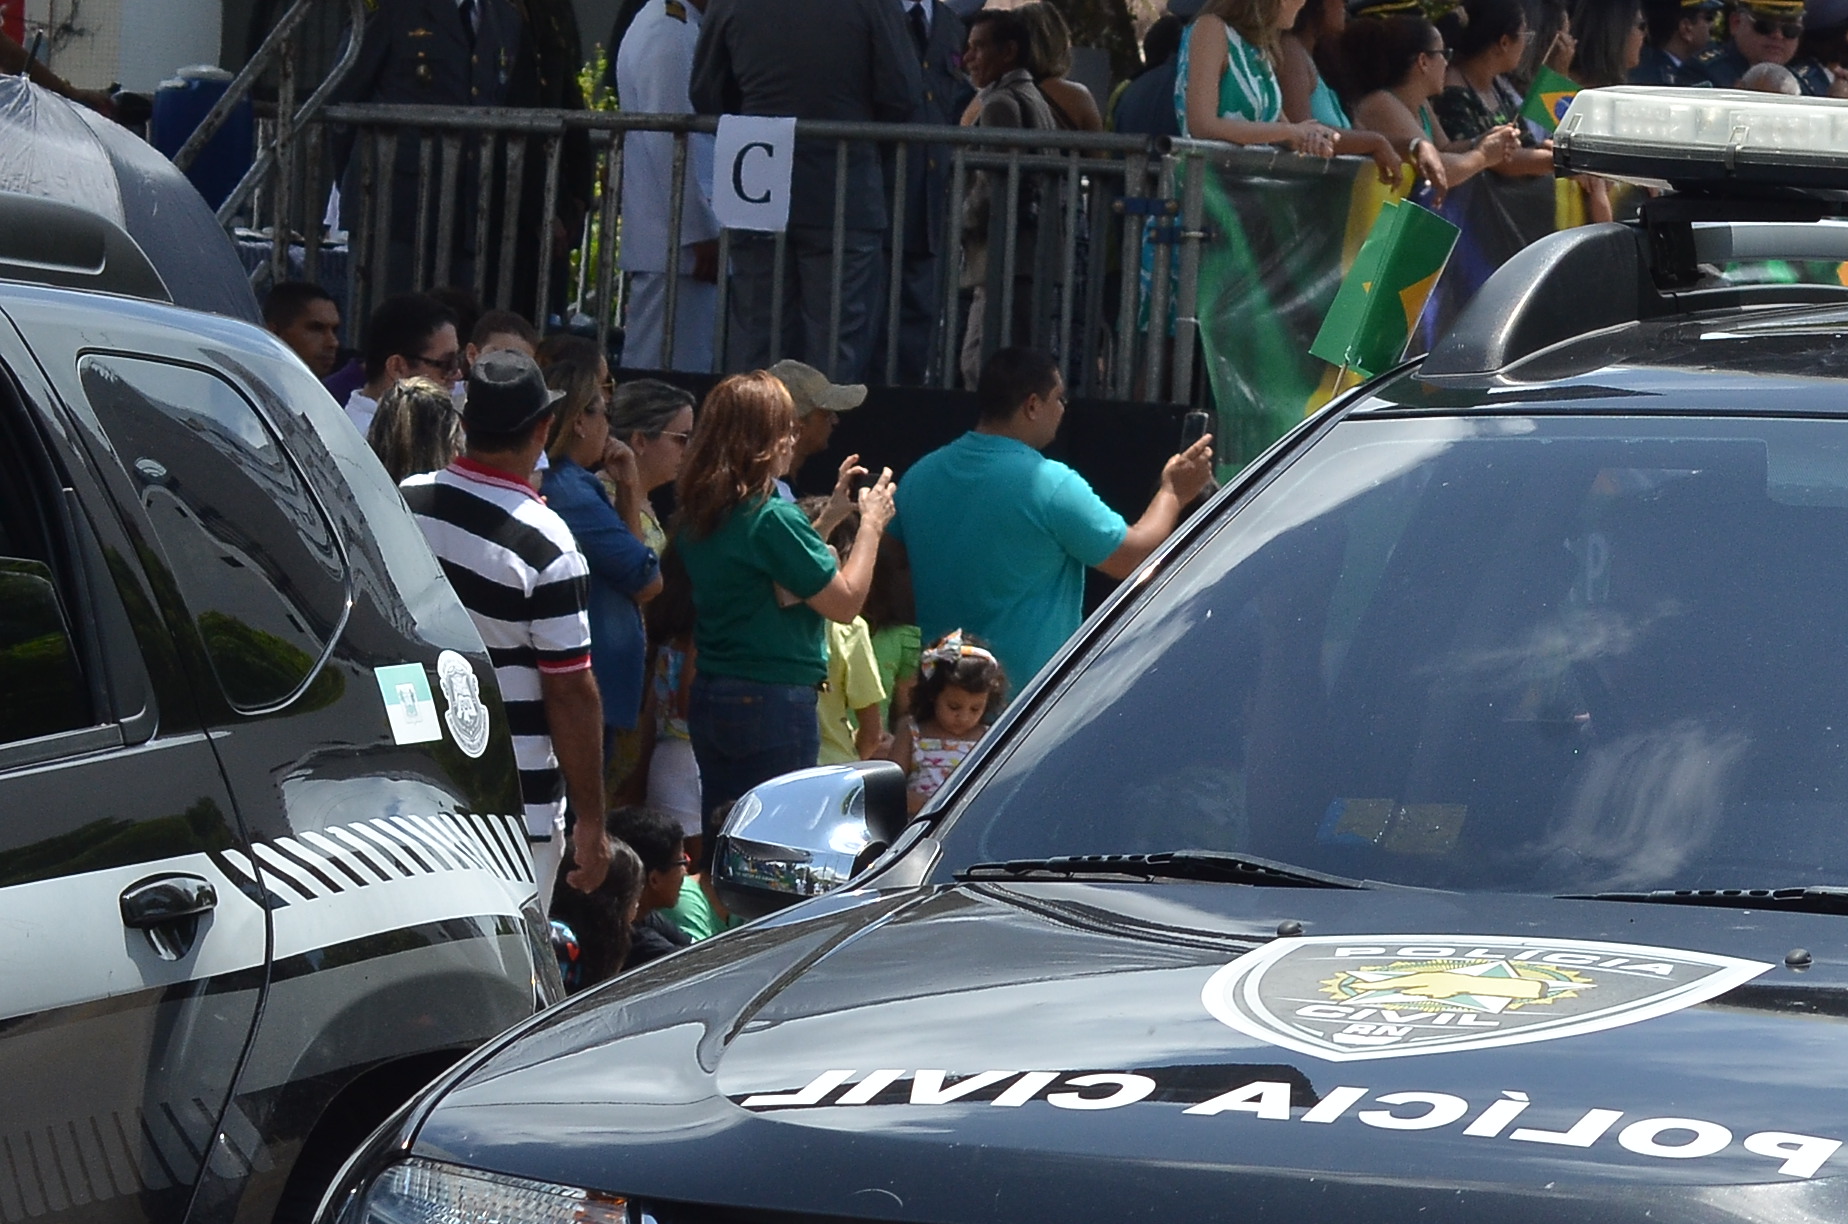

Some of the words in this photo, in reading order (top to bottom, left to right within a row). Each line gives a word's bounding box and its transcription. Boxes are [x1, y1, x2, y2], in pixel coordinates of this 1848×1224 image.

[732, 141, 774, 204] C
[1294, 1003, 1501, 1028] CIVIL
[1341, 1023, 1416, 1037] RN
